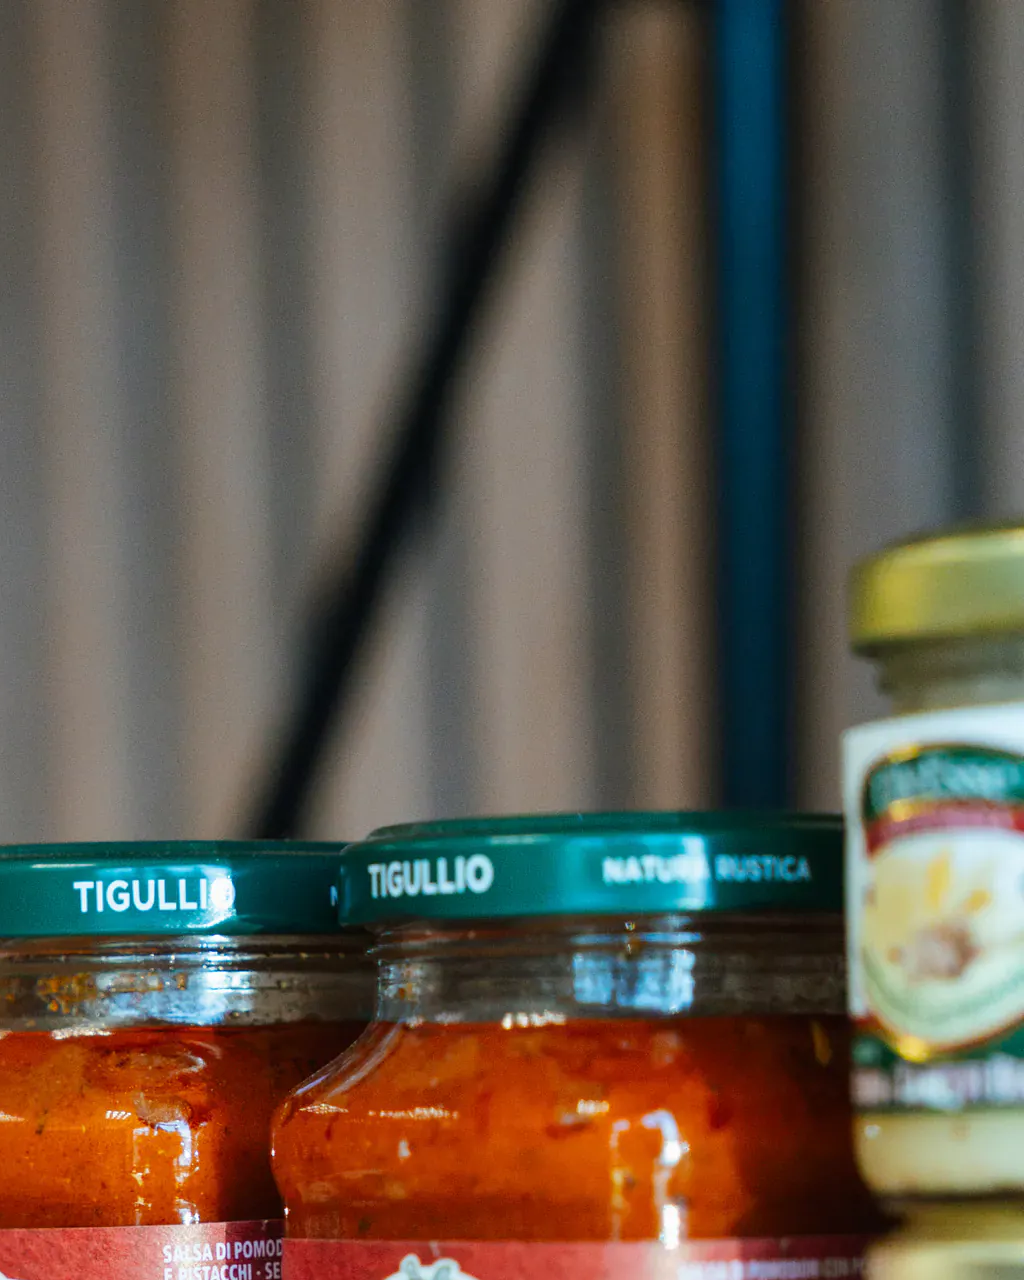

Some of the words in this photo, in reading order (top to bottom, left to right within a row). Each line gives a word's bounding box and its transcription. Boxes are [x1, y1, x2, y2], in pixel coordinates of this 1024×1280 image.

[368, 854, 494, 898] TIGULLIO
[602, 854, 711, 884] NATURA
[715, 854, 812, 882] RUSTICA
[73, 877, 236, 913] TIGULLIO
[163, 1242, 213, 1264] SALSA
[216, 1241, 231, 1261] DI
[265, 1261, 282, 1280] SE
